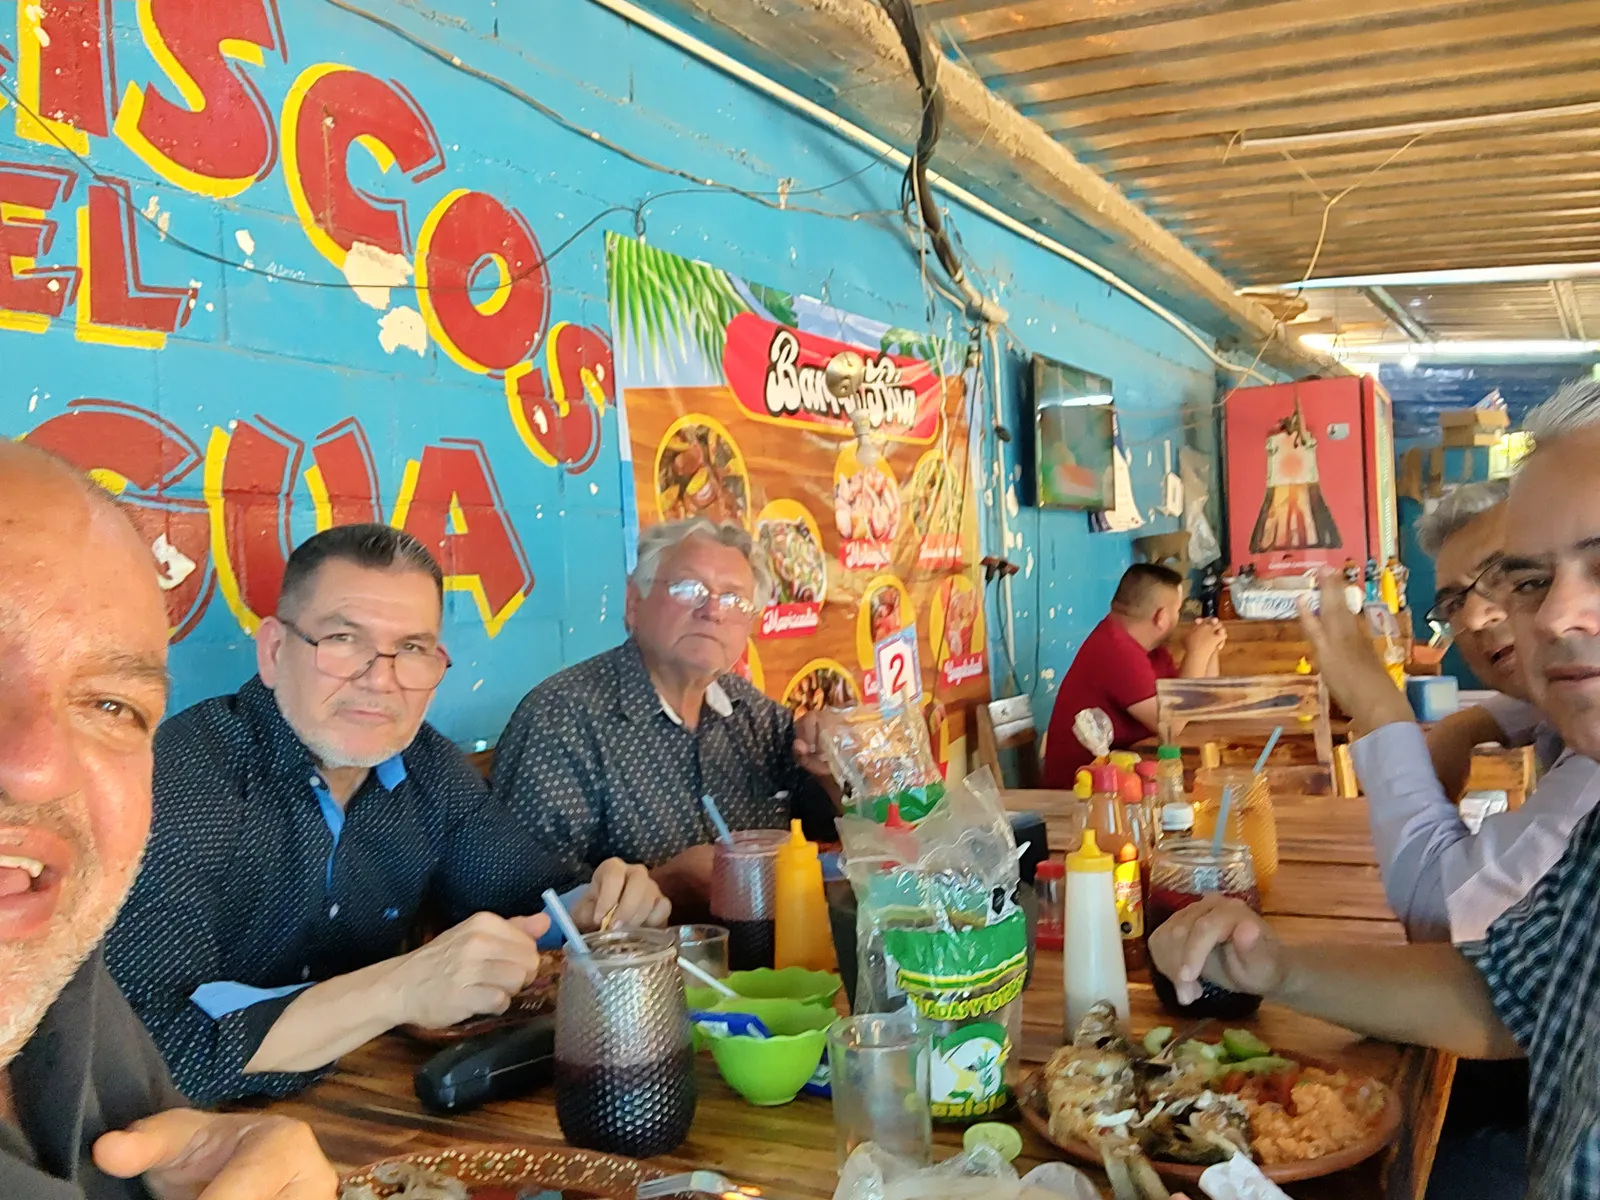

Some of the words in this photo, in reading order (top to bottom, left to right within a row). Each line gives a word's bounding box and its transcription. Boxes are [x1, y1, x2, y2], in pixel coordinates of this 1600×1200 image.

[0, 0, 613, 474] ISCOS
[0, 161, 199, 349] EL
[889, 653, 908, 696] 2
